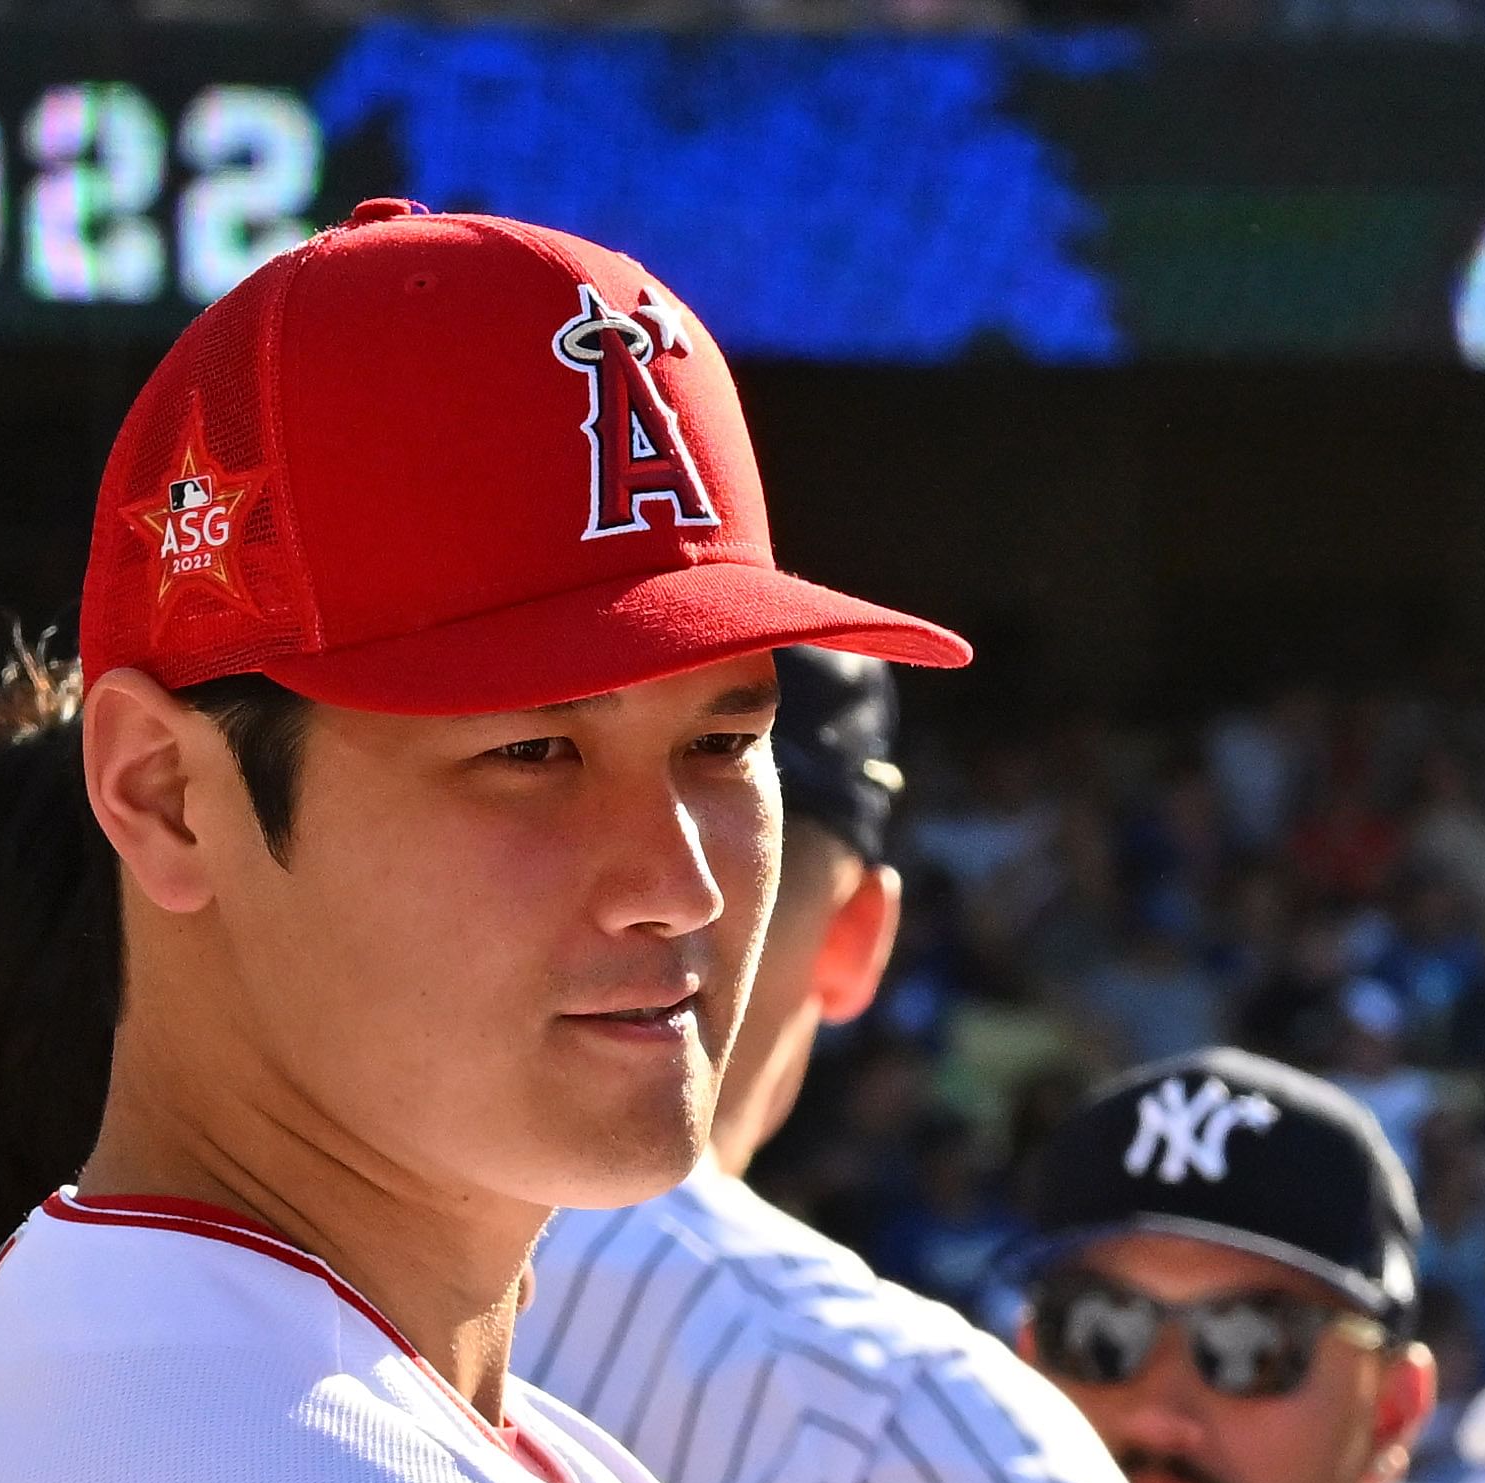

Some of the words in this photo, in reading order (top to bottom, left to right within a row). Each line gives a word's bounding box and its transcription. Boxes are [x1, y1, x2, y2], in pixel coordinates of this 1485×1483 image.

[552, 283, 722, 541] A
[160, 506, 230, 560] ASG
[172, 552, 213, 574] 2022
